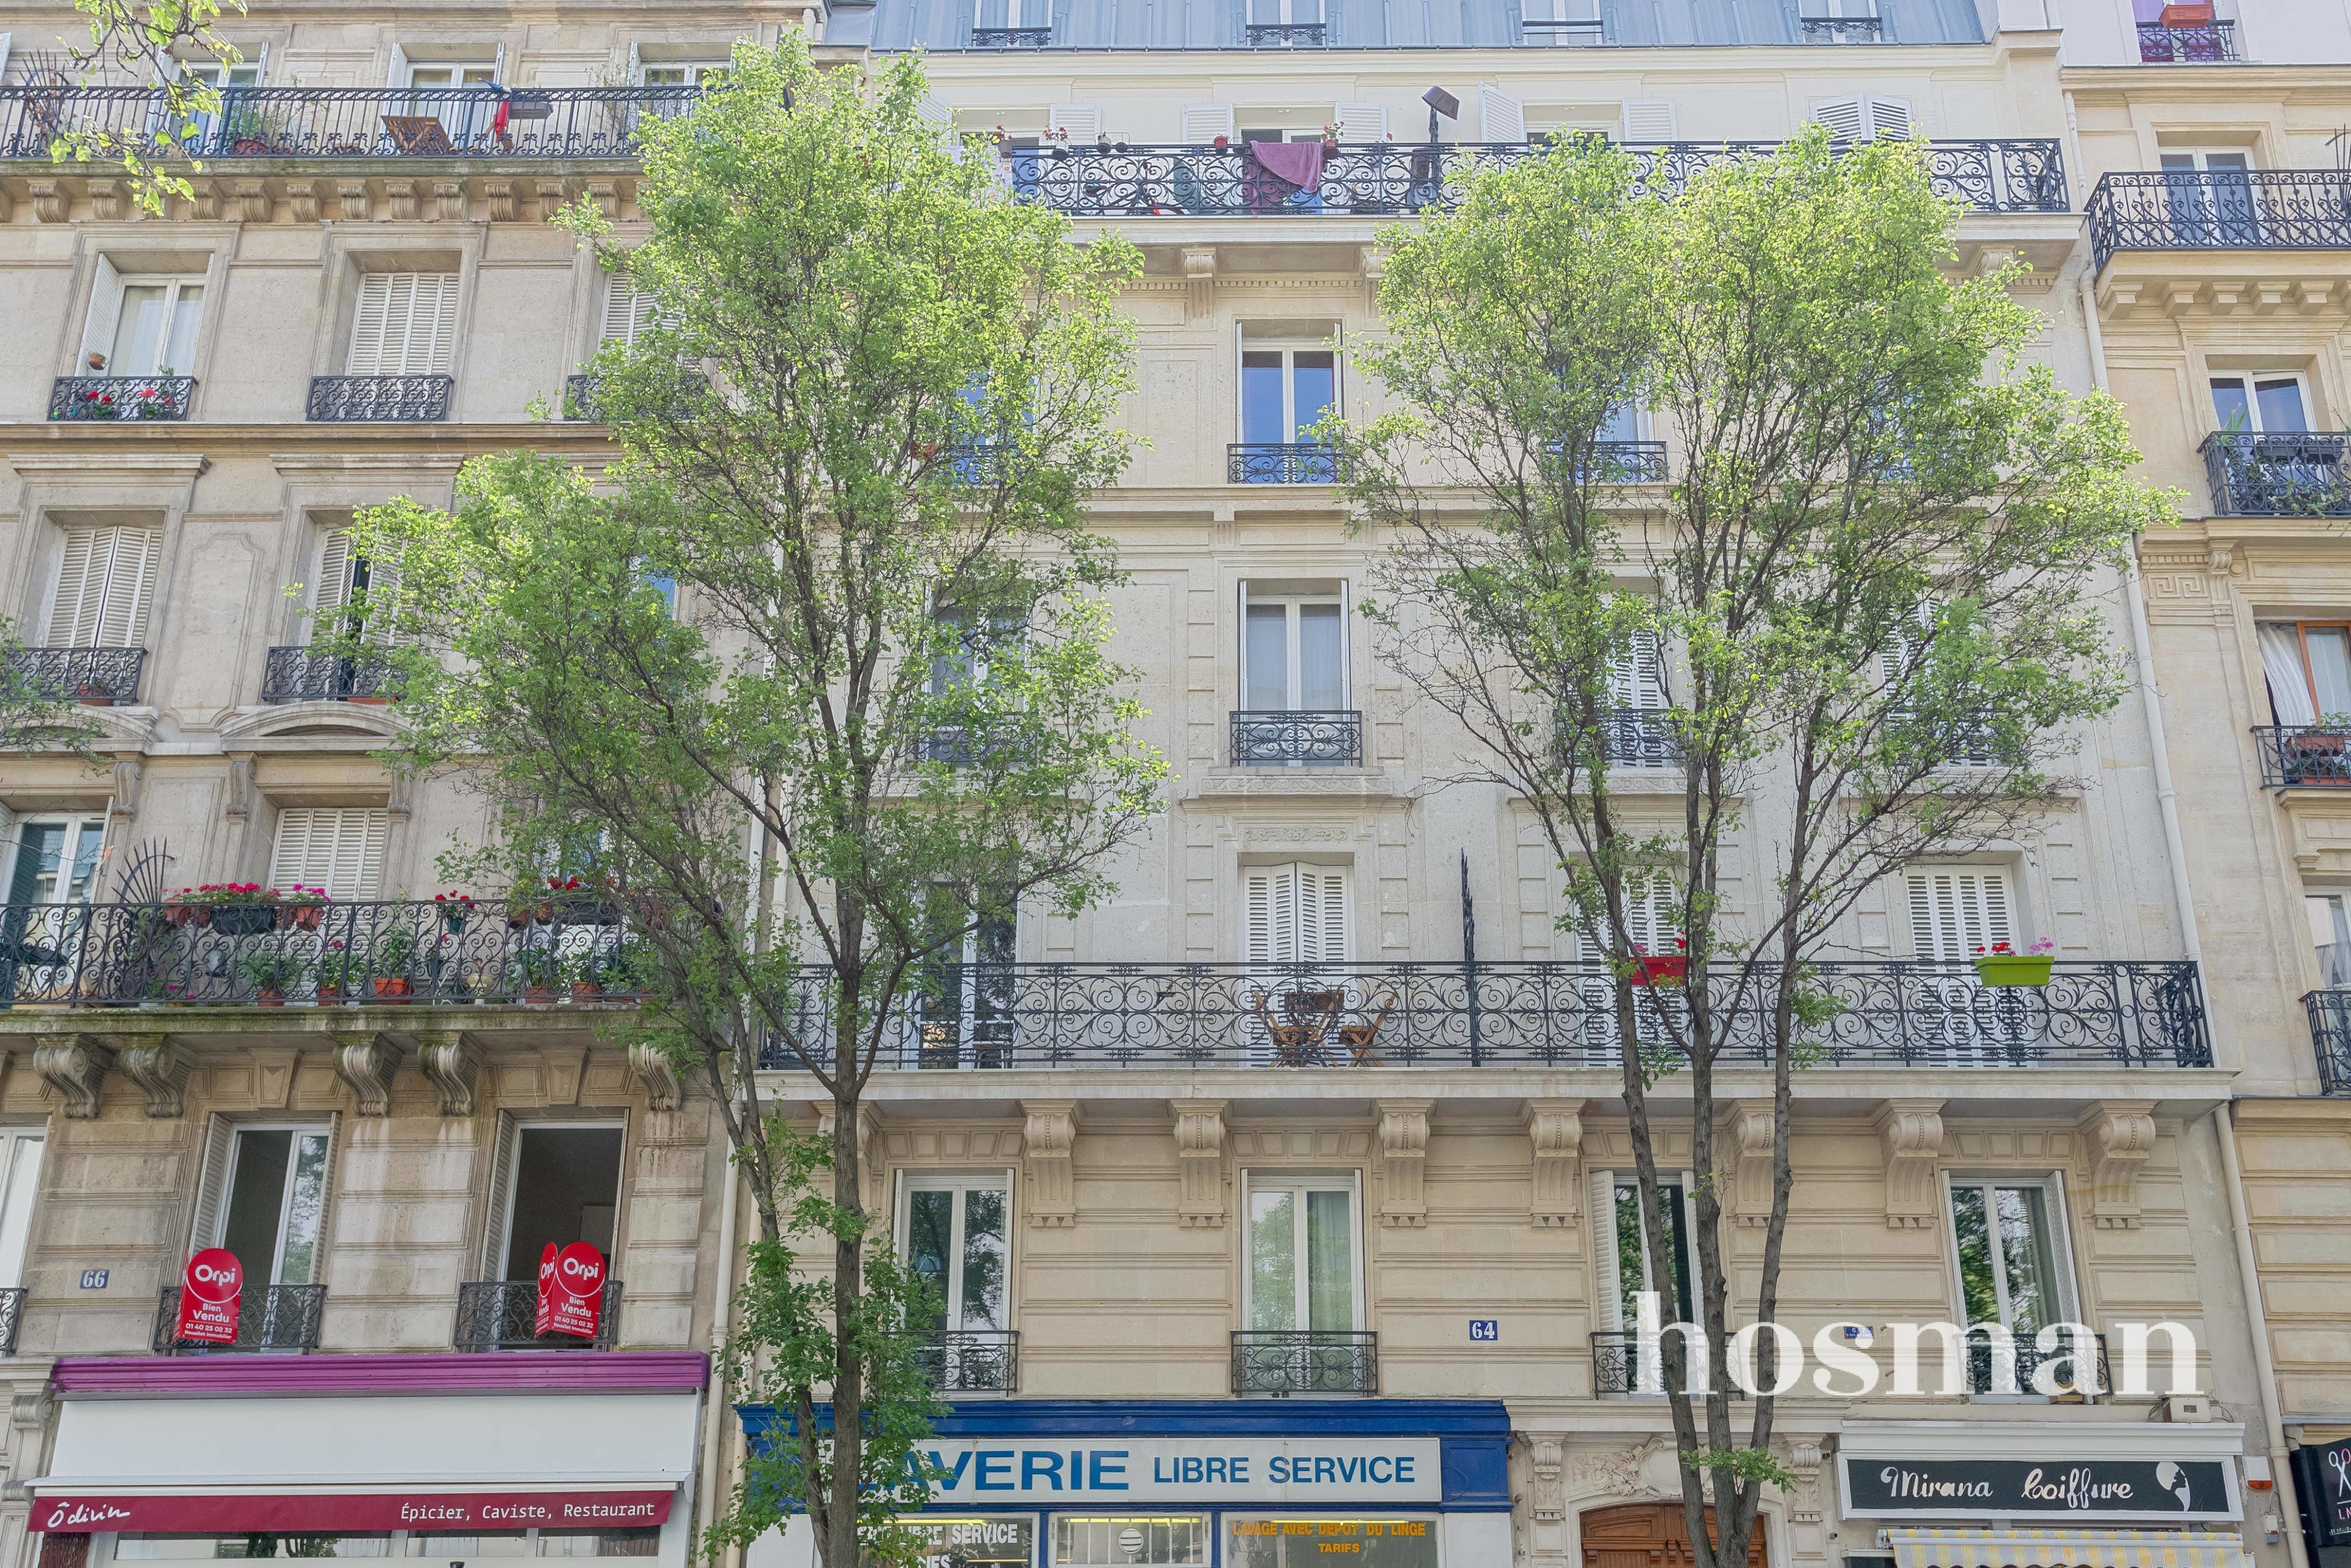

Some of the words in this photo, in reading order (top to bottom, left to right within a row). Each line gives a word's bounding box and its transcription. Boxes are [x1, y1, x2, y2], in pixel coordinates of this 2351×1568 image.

[195, 1264, 235, 1287] Orpi
[541, 1256, 555, 1279] Orpi
[563, 1258, 599, 1281] Orpi
[83, 1270, 106, 1288] 66
[203, 1303, 221, 1312] Bien
[561, 1302, 591, 1317] Vendu
[569, 1296, 585, 1306] Bien
[193, 1309, 229, 1322] Vendu
[1472, 1322, 1495, 1339] 64
[1154, 1456, 1249, 1483] LIBRE
[1268, 1456, 1415, 1483] SERVICE
[1880, 1466, 1993, 1498] Mirana
[401, 1503, 470, 1522] Épicier,
[483, 1504, 552, 1520] Caviste,
[564, 1503, 655, 1517] Restaurant
[951, 1523, 1018, 1543] SERVICE
[1233, 1522, 1277, 1535] LAVAGE
[1282, 1522, 1313, 1535] AVEC
[1366, 1522, 1383, 1536] DU
[1390, 1522, 1426, 1536] LINGE
[1318, 1543, 1360, 1553] TARIFS
